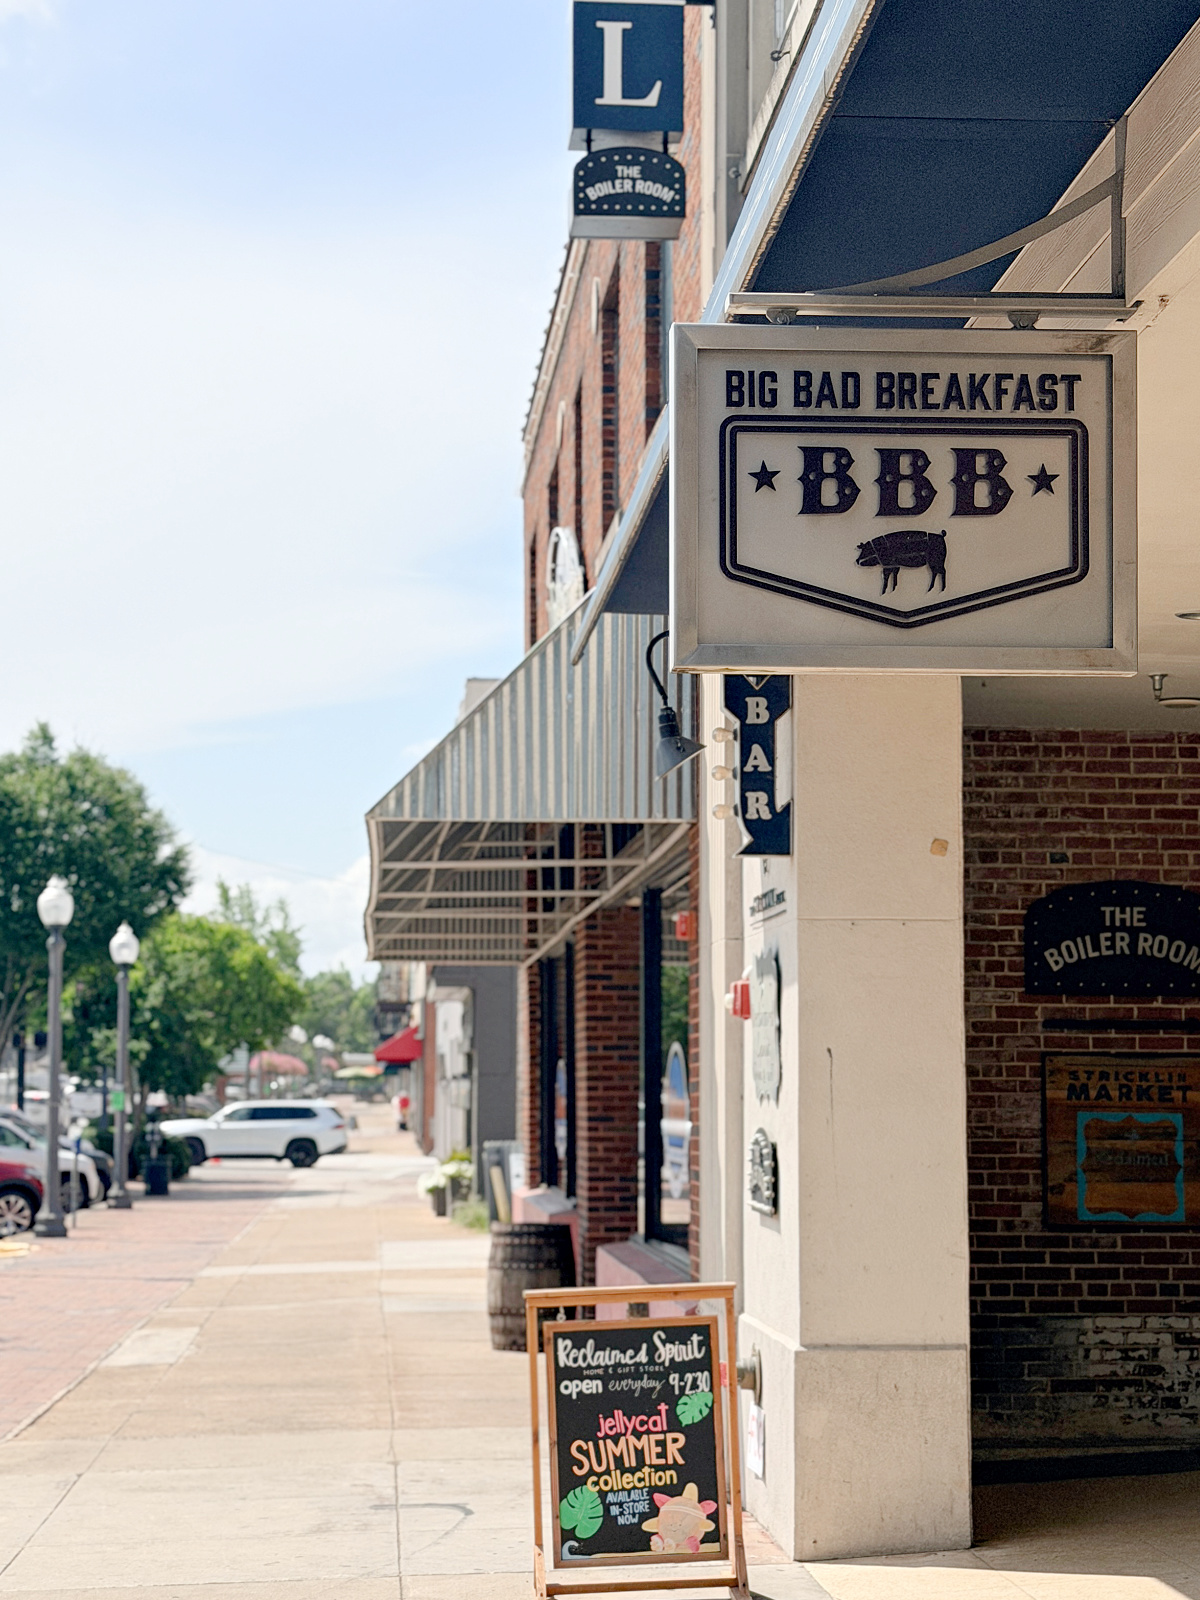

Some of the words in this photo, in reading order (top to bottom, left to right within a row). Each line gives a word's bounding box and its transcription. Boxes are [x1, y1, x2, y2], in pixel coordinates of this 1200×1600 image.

[594, 20, 662, 107] L
[615, 165, 641, 179] THE
[585, 179, 633, 201] BOILER
[635, 180, 675, 203] ROOM
[725, 370, 779, 409] BIG
[792, 371, 861, 410] BAD
[875, 372, 1082, 413] BREAKFAST
[797, 446, 1014, 518] BBB
[743, 697, 772, 820] BAR
[1100, 906, 1147, 927] THE
[1043, 932, 1131, 972] BOILER
[1068, 1070, 1187, 1083] STRICKLIN
[1066, 1084, 1193, 1103] MARKET
[557, 1337, 649, 1368] Reclaimed
[652, 1330, 706, 1367] Spirit
[617, 1366, 635, 1374] GIFT
[639, 1365, 665, 1373] STORE
[560, 1378, 603, 1400] open
[608, 1374, 666, 1399] everyday
[596, 1402, 669, 1438] jellycat
[570, 1432, 686, 1476] SUMMER
[586, 1465, 678, 1492] collection
[606, 1488, 649, 1504] AVAILABLE
[610, 1501, 650, 1516] IN-STORE
[617, 1514, 640, 1526] NOW
